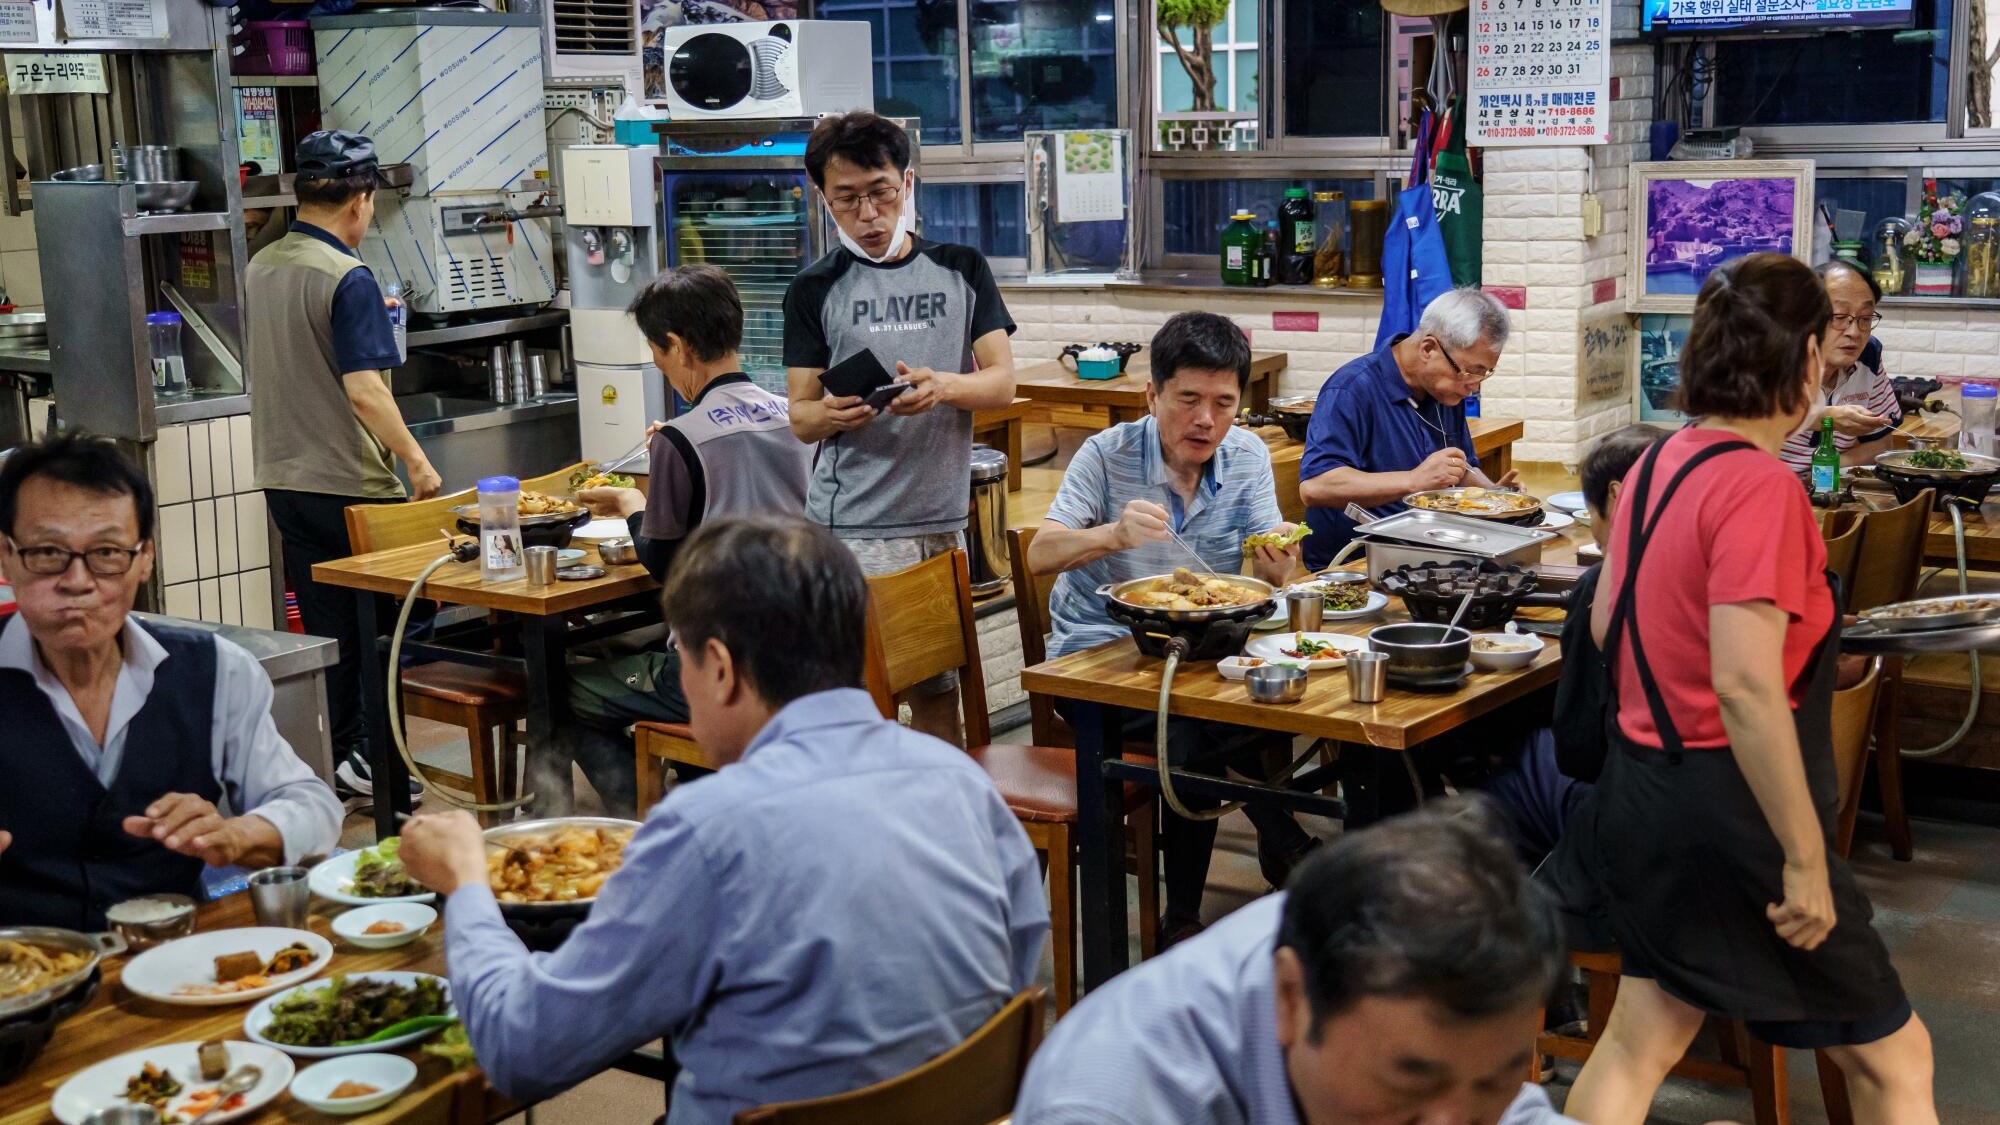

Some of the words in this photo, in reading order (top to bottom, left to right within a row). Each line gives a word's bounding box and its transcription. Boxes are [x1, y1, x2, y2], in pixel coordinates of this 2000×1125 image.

[1481, 0, 1488, 10] 5
[1498, 0, 1506, 10] 6
[1517, 0, 1523, 9] 7
[1535, 0, 1542, 8] 8
[1672, 0, 1696, 15] 가혹
[1699, 0, 1724, 15] 행위
[1727, 0, 1751, 13] 실태
[1478, 23, 1490, 33] 12
[1496, 22, 1508, 32] 13
[1514, 21, 1526, 31] 14
[1532, 20, 1544, 30] 15
[1550, 19, 1562, 29] 16
[1569, 18, 1581, 29] 17
[1587, 17, 1600, 28] 18
[1478, 45, 1490, 55] 19
[1494, 44, 1508, 55] 20
[1513, 43, 1526, 54] 21
[1531, 43, 1544, 53] 22
[1548, 42, 1562, 52] 23
[1567, 41, 1581, 51] 24
[1585, 40, 1600, 51] 25
[16, 62, 86, 82] 구온누리약국
[439, 55, 468, 78] WOOSUNG
[1476, 67, 1490, 77] 26
[1494, 66, 1508, 77] 27
[1512, 66, 1526, 76] 28
[1530, 65, 1544, 76] 29
[1547, 64, 1563, 75] 30
[1567, 63, 1580, 74] 31
[1478, 94, 1522, 108] 개인택시
[1552, 91, 1596, 106] 매매전문
[443, 106, 471, 129] WOOSUNG
[1487, 127, 1536, 138] 010-3723-0580
[1545, 126, 1595, 136] 010-3722-0580
[852, 291, 947, 326] PLAYER
